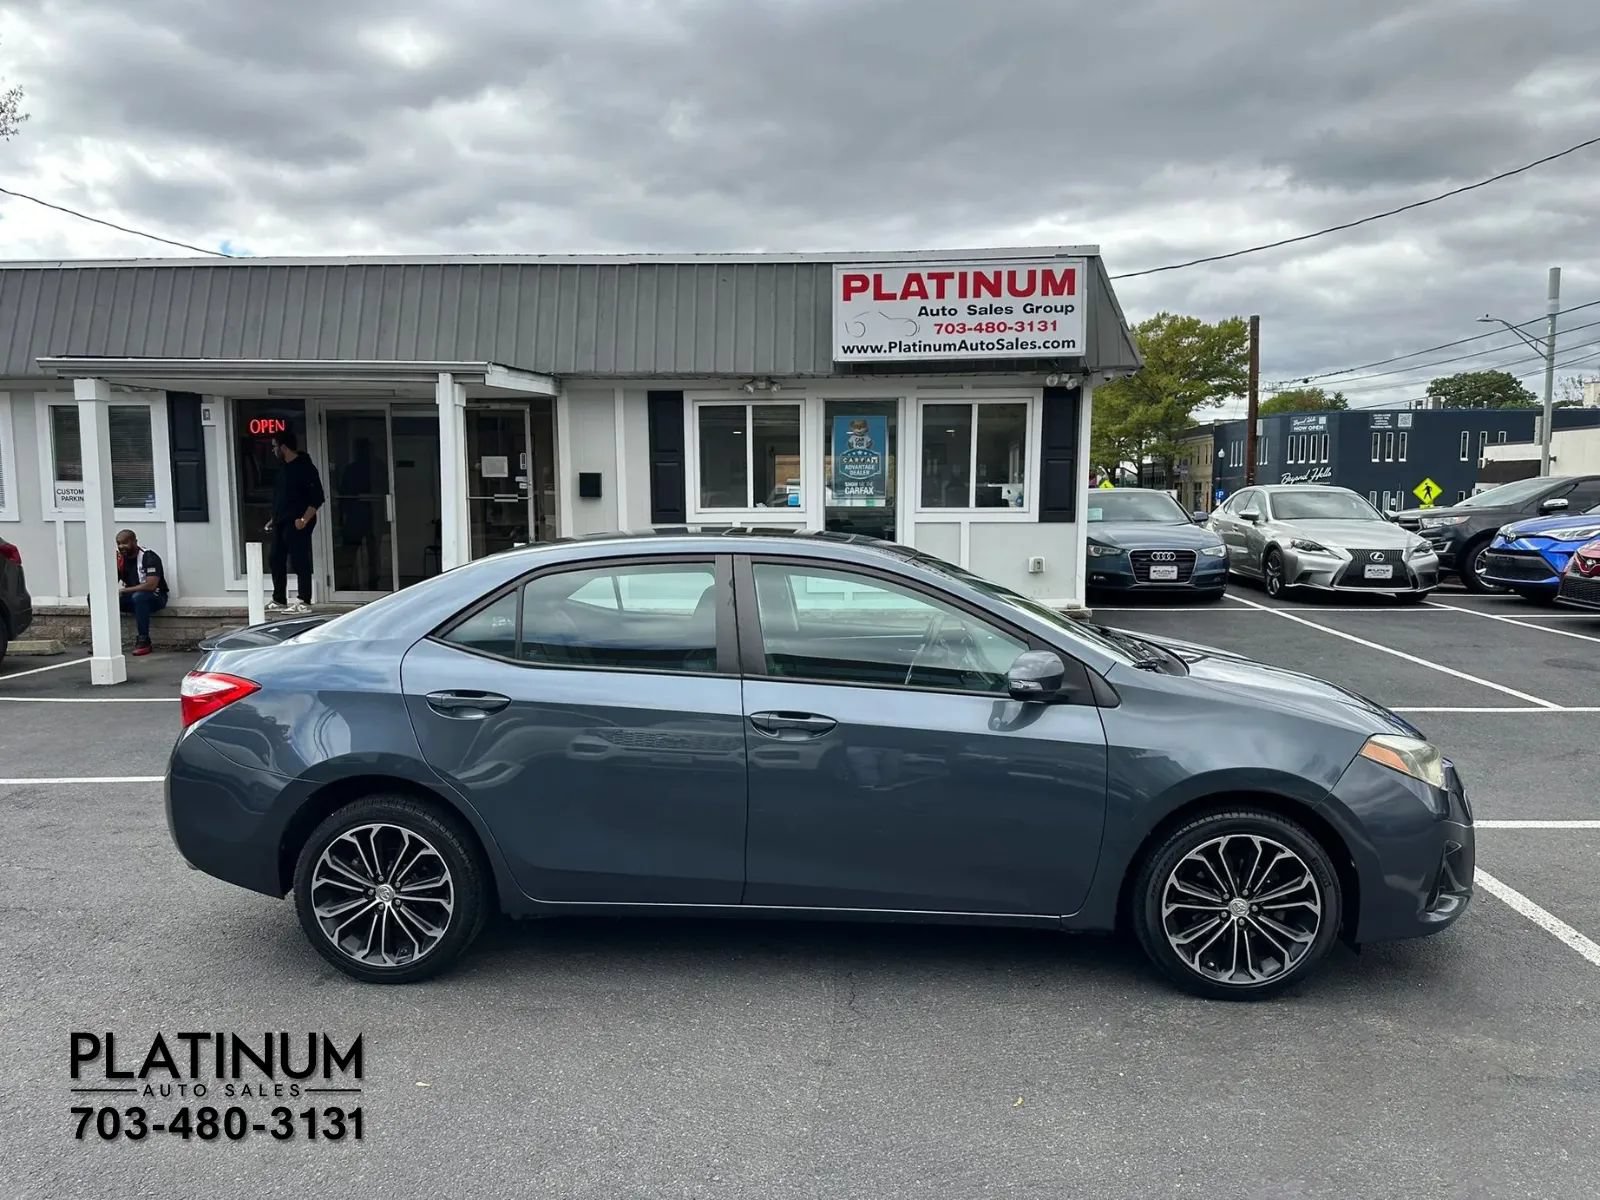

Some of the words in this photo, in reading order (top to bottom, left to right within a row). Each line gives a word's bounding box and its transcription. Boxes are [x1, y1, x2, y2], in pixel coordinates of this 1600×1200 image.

[842, 268, 1076, 302] PLATINUM
[917, 305, 958, 318] Auto
[966, 303, 1014, 316] Sales
[1022, 302, 1075, 315] Group
[933, 320, 1058, 335] 703-480-3131
[842, 337, 1076, 354] www.PlatinumAutoSales.com
[250, 418, 285, 434] OPEN
[844, 486, 874, 495] CARFAX
